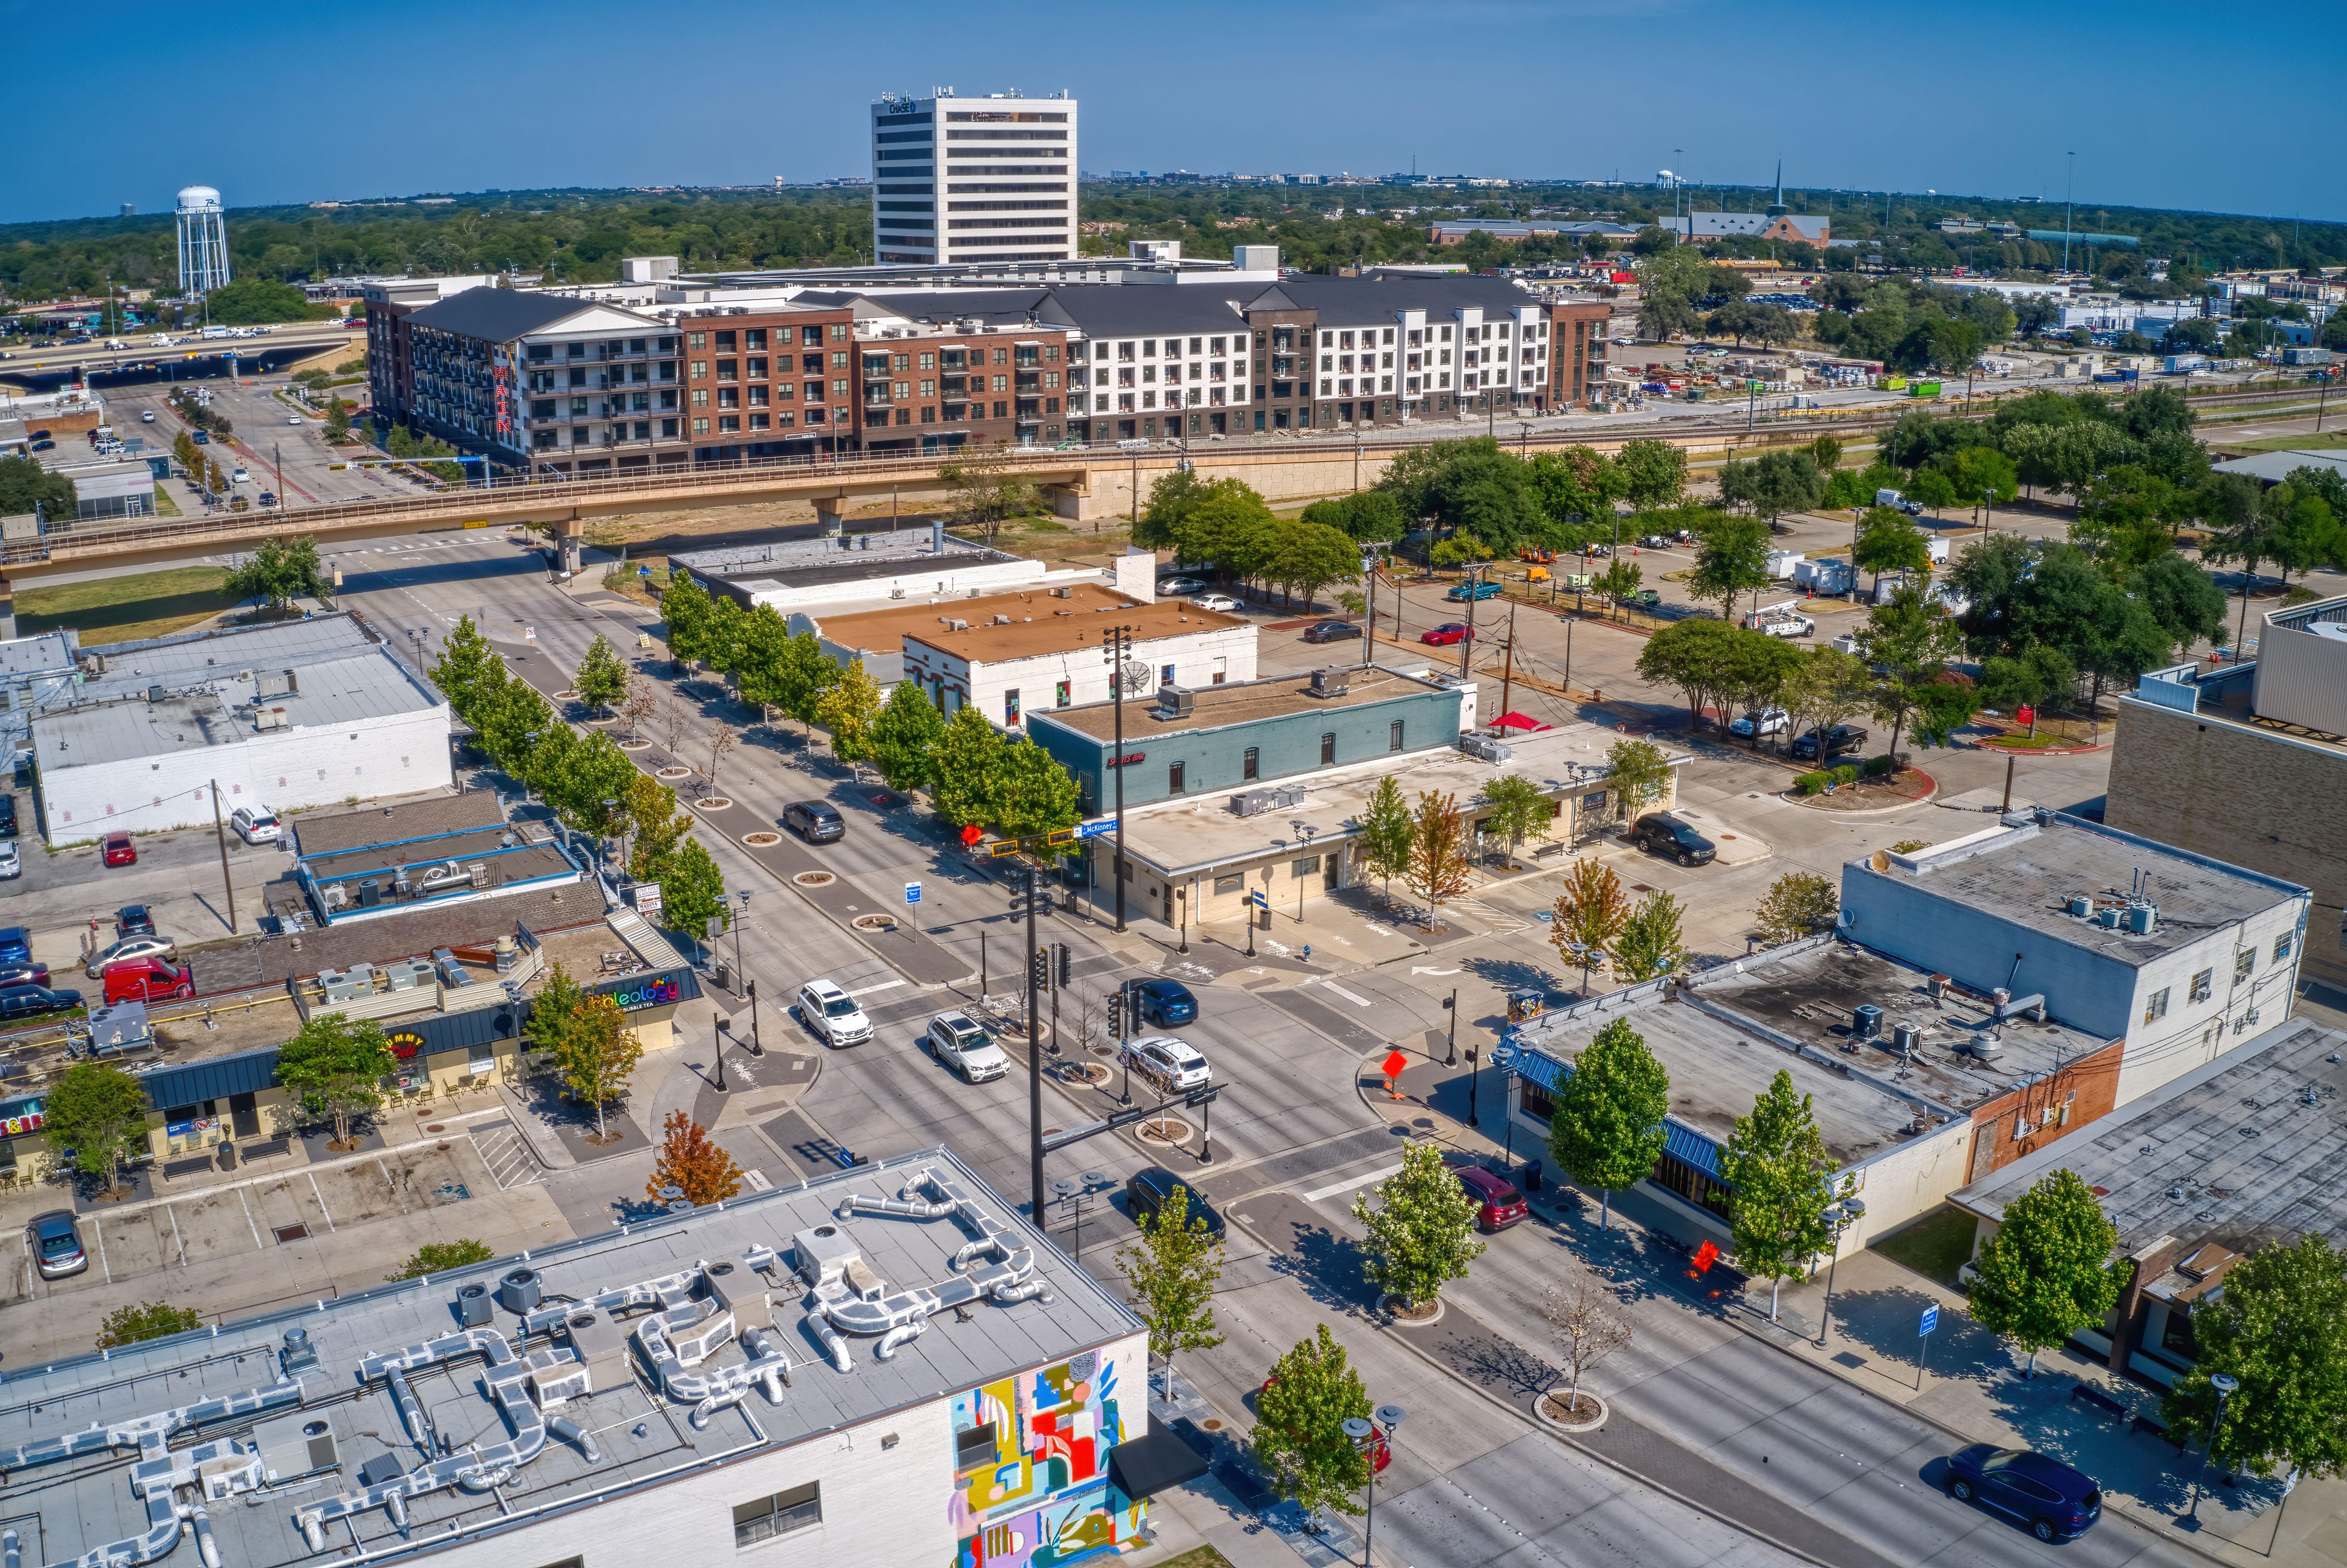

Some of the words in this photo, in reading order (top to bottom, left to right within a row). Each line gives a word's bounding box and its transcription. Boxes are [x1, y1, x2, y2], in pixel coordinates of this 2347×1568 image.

[890, 103, 910, 114] CHASE
[494, 365, 510, 432] MAIN
[1132, 753, 1145, 761] BAR
[1087, 823, 1112, 832] McKinney
[379, 1034, 423, 1051] YUMMY
